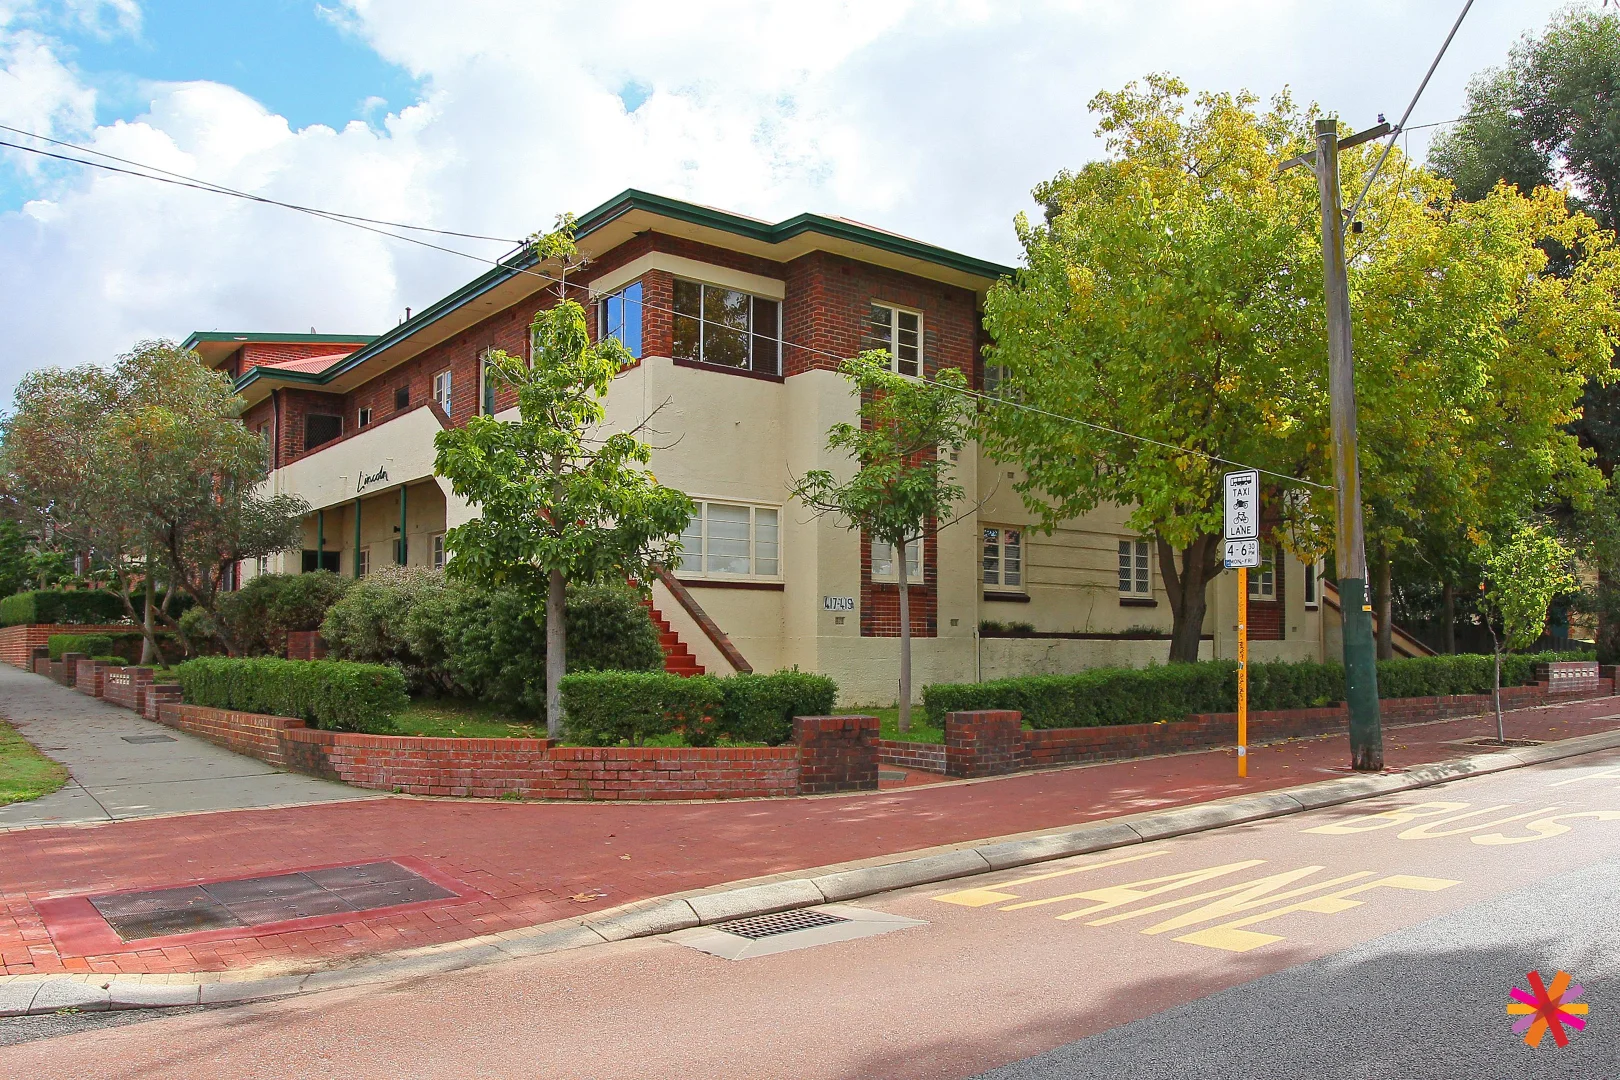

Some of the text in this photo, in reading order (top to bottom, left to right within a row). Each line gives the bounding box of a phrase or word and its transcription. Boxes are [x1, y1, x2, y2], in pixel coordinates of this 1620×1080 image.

[357, 465, 389, 493] Lincoln
[1233, 488, 1250, 497] TAXI
[1231, 525, 1252, 536] LANE
[824, 596, 854, 610] 417-419
[1299, 802, 1620, 845] BUS
[928, 850, 1464, 952] LANE
